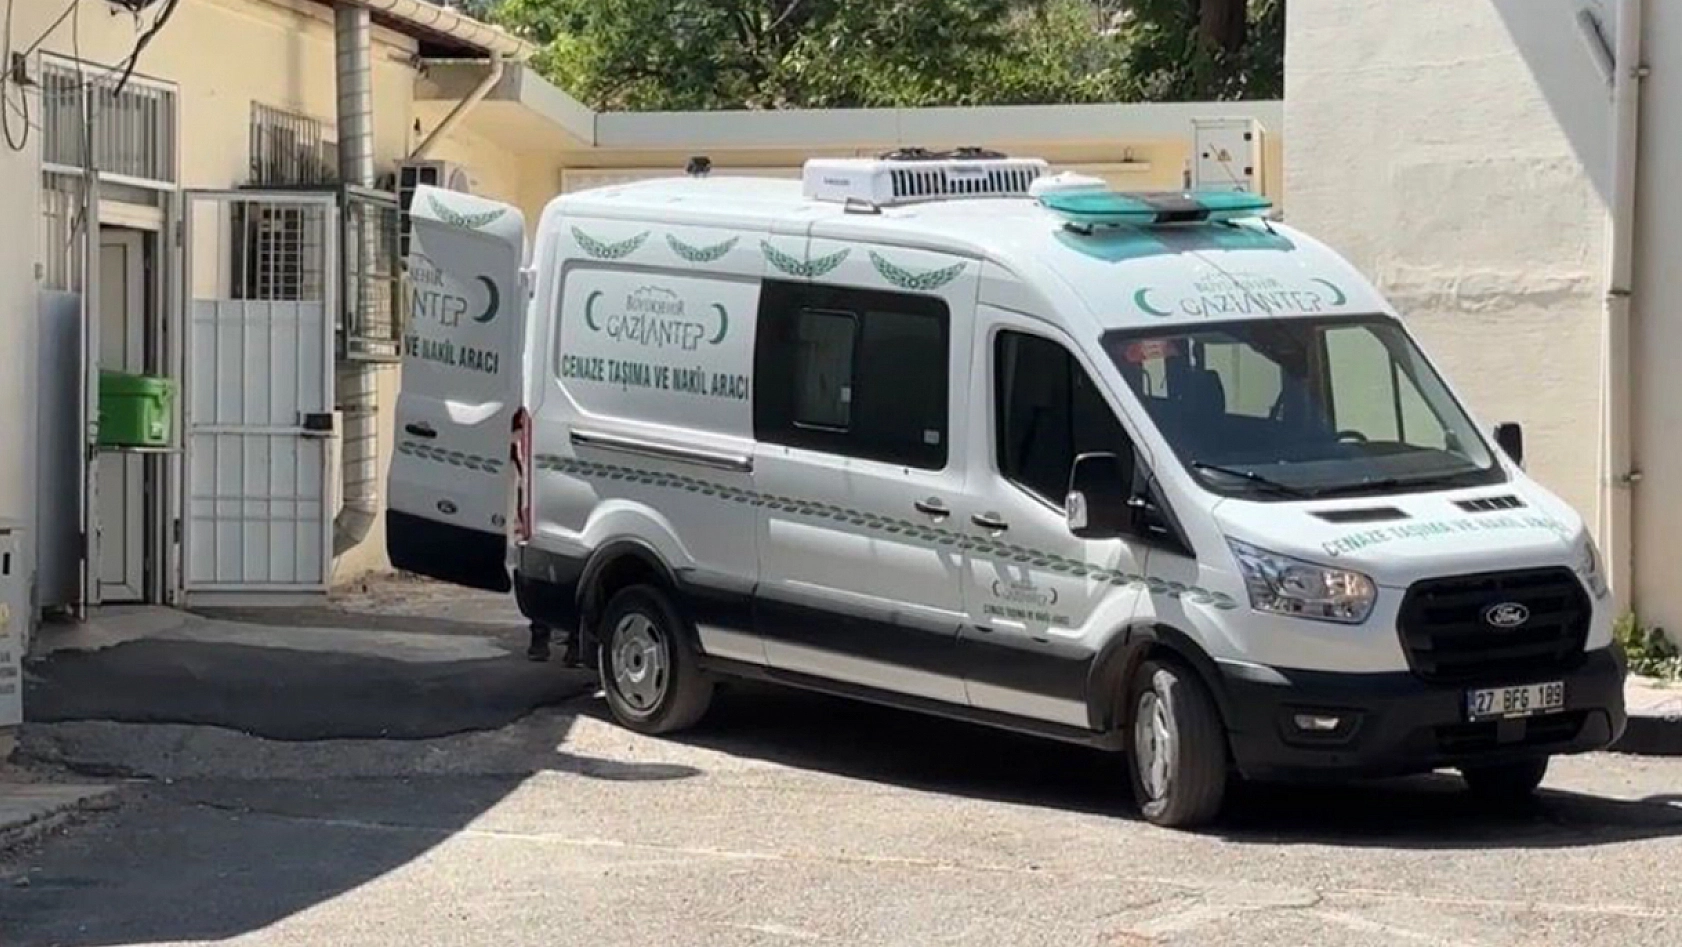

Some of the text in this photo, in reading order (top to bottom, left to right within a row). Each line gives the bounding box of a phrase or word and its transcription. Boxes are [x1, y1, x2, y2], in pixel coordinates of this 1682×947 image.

[459, 345, 499, 374] ARACI
[562, 355, 604, 382] CENAZE
[607, 359, 652, 392] TAŞIMA
[654, 366, 669, 389] VE
[709, 373, 749, 401] ARACI
[1321, 529, 1391, 557] CENAZE
[1478, 691, 1494, 713] 27
